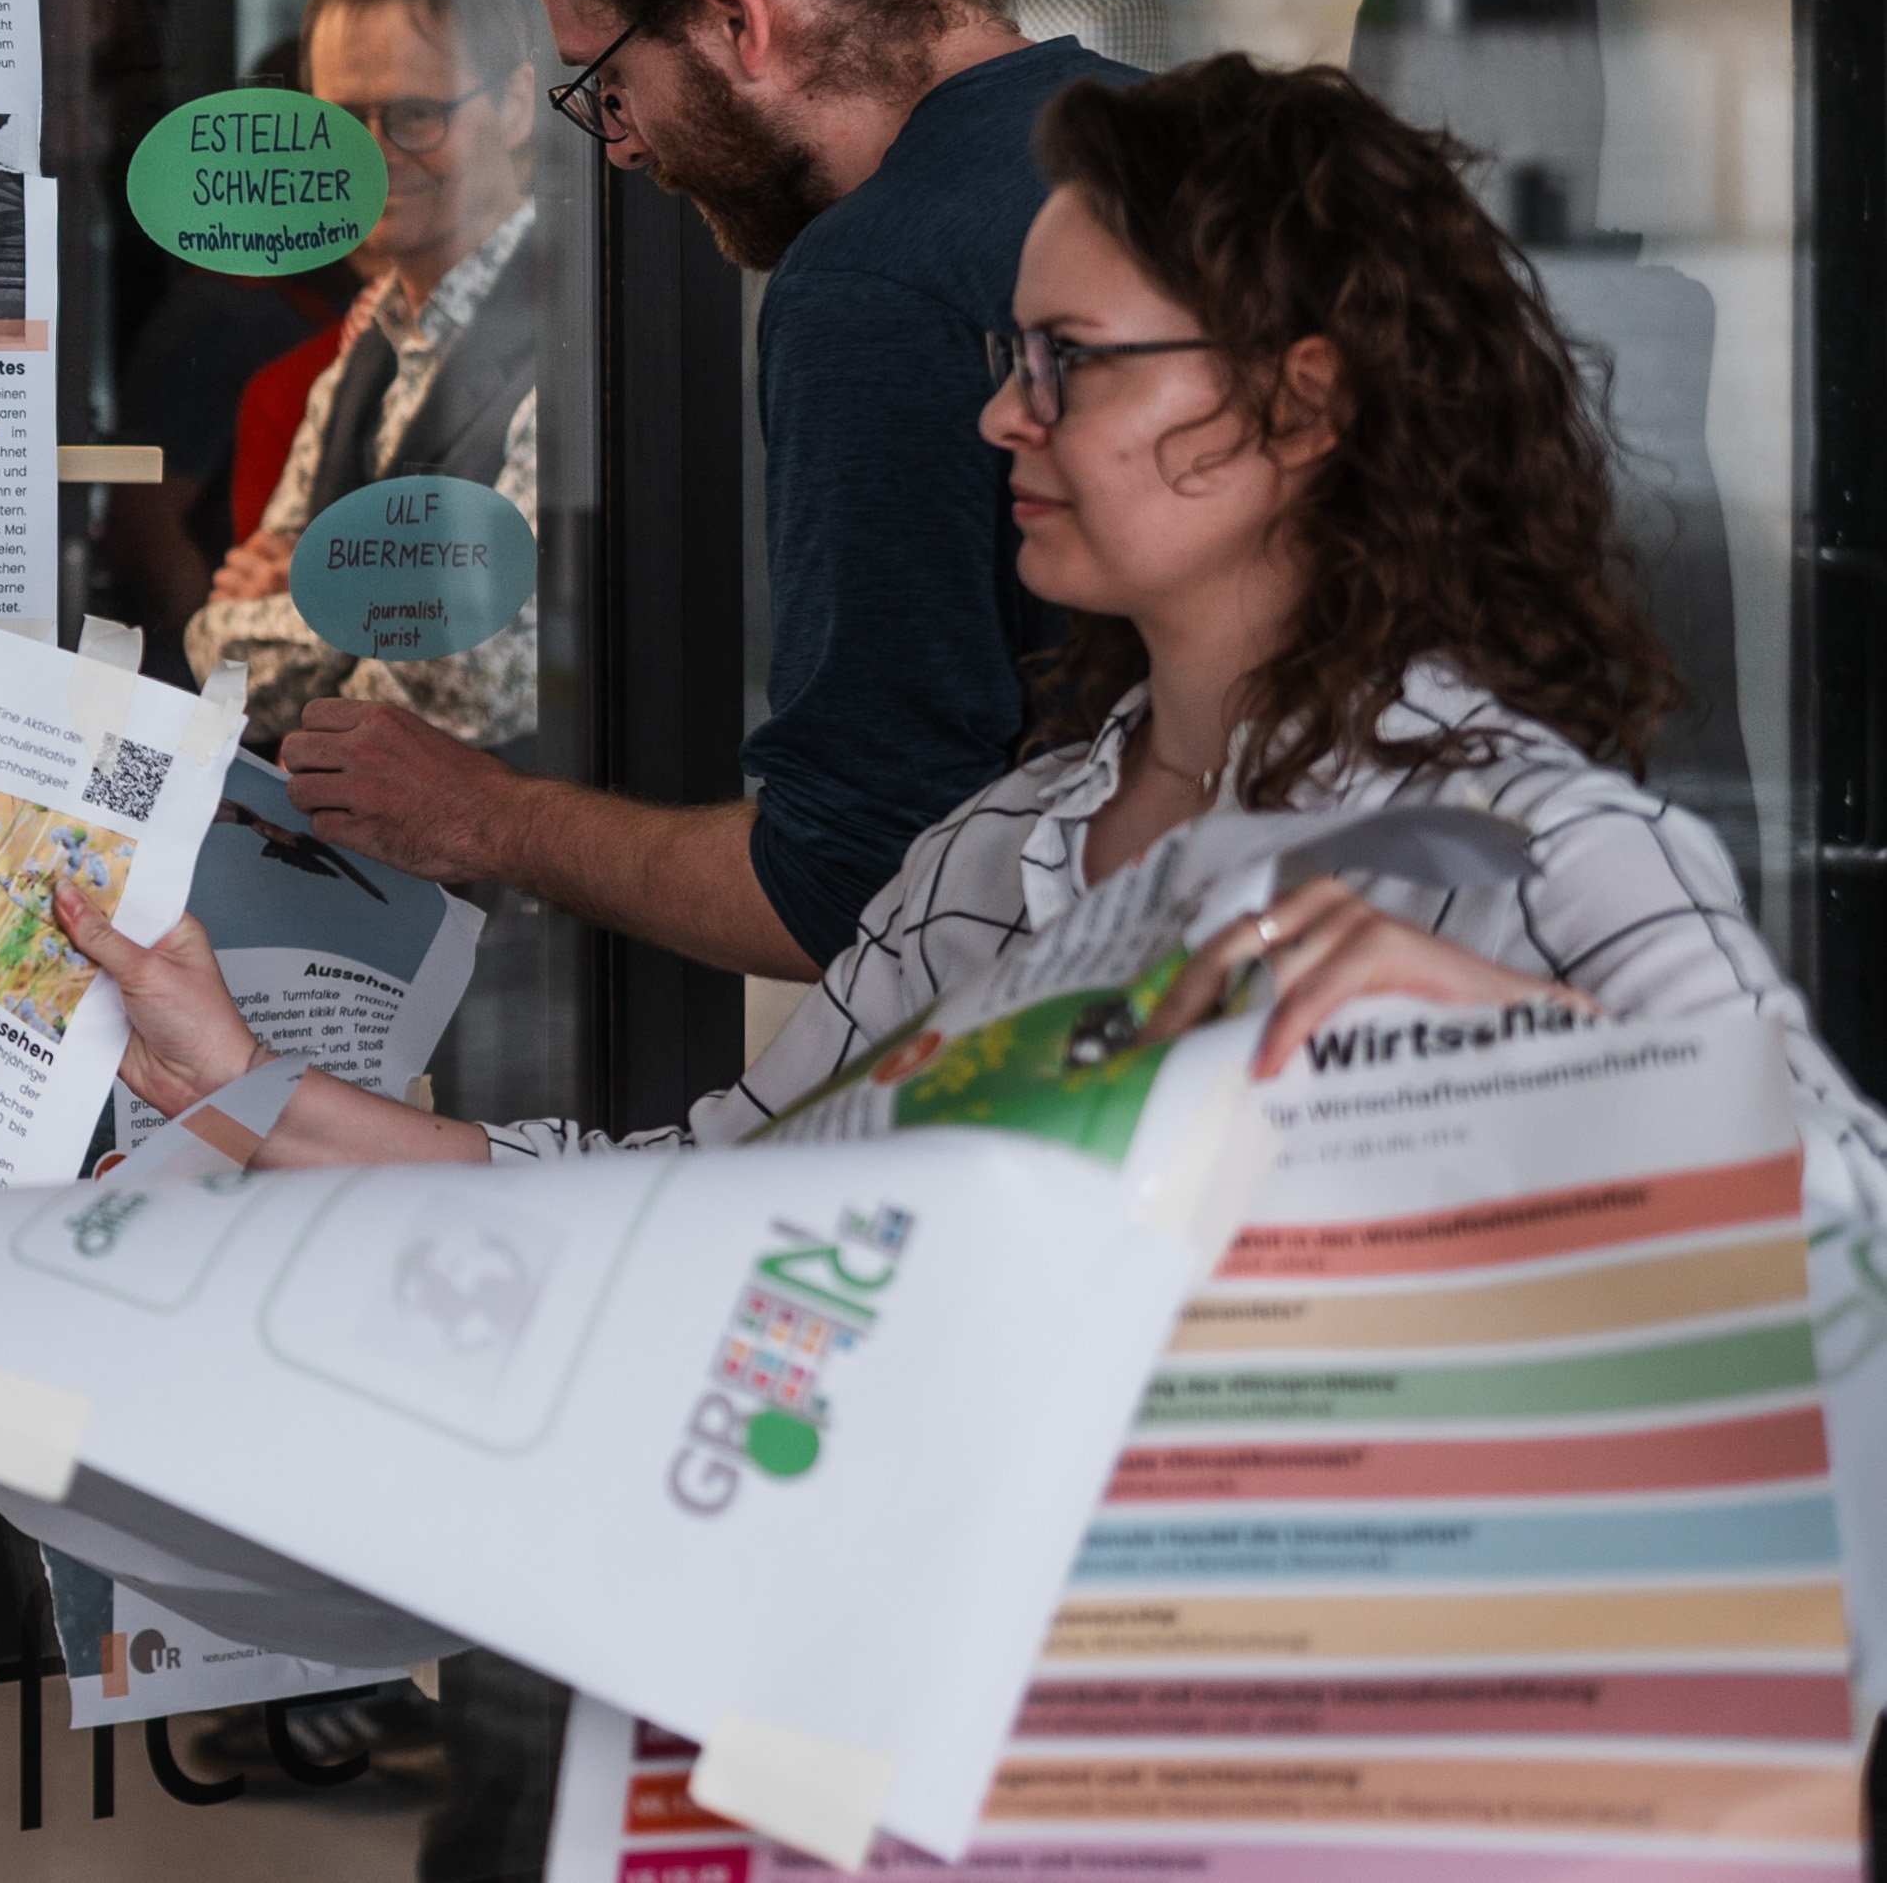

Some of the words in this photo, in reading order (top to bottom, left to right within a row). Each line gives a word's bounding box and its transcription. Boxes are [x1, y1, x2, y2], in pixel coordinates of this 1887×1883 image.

[190, 111, 331, 154] ESTELLA
[178, 218, 359, 265] ernährungsberaterin
[386, 493, 440, 525] ULF
[327, 538, 489, 570] BUERMEYER
[363, 598, 448, 632] journalist,
[372, 626, 421, 659] jurist
[23, 717, 61, 737] Aktion
[63, 730, 83, 744] der
[282, 989, 341, 1002] Turmfalke
[303, 963, 404, 998] Aussehen
